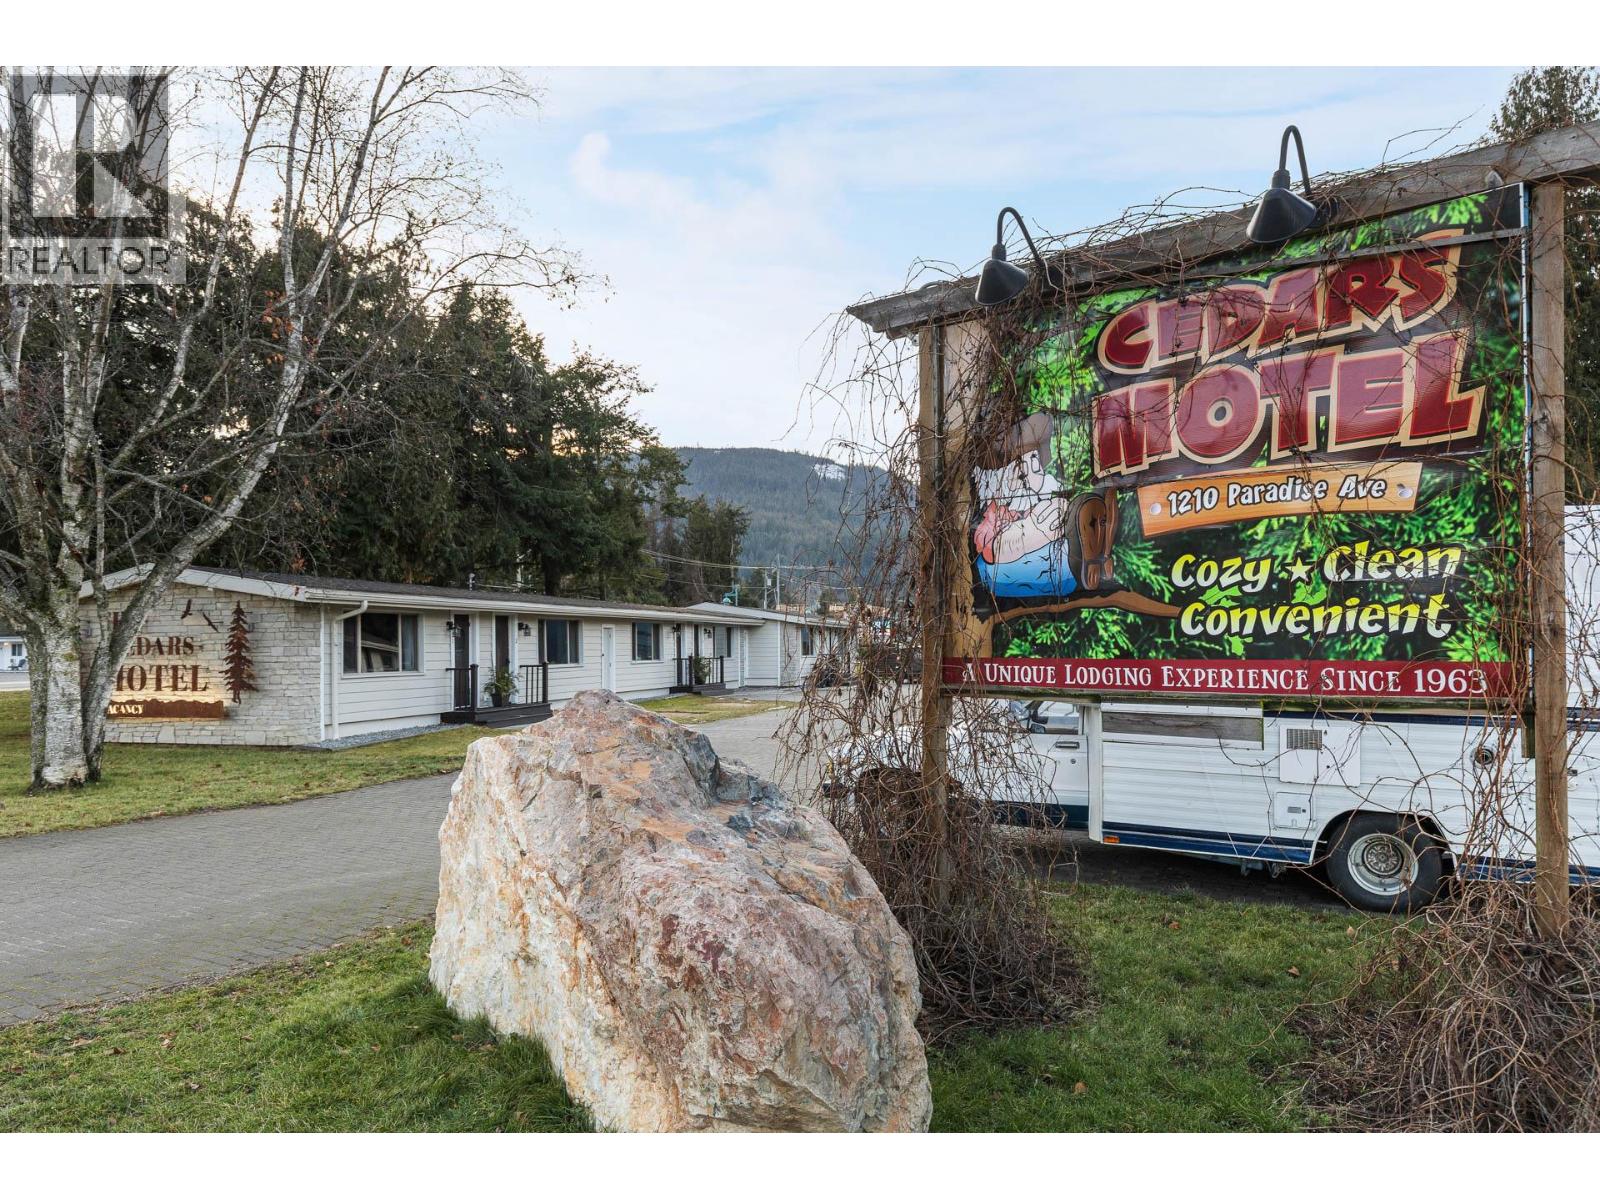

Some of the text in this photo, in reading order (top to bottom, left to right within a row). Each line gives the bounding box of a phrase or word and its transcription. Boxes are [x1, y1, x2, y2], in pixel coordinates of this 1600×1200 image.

[1098, 229, 1466, 376] CEDARS
[1092, 327, 1487, 478] MOTEL
[1167, 474, 1388, 517] 1210 Paradise Ave
[1171, 540, 1464, 593] Cozy Clean
[1180, 593, 1452, 639] Convenient
[962, 662, 1488, 694] A UNIQUE LODGING EXPERIENCE SINCE 1963
[106, 704, 145, 715] ACANCY
